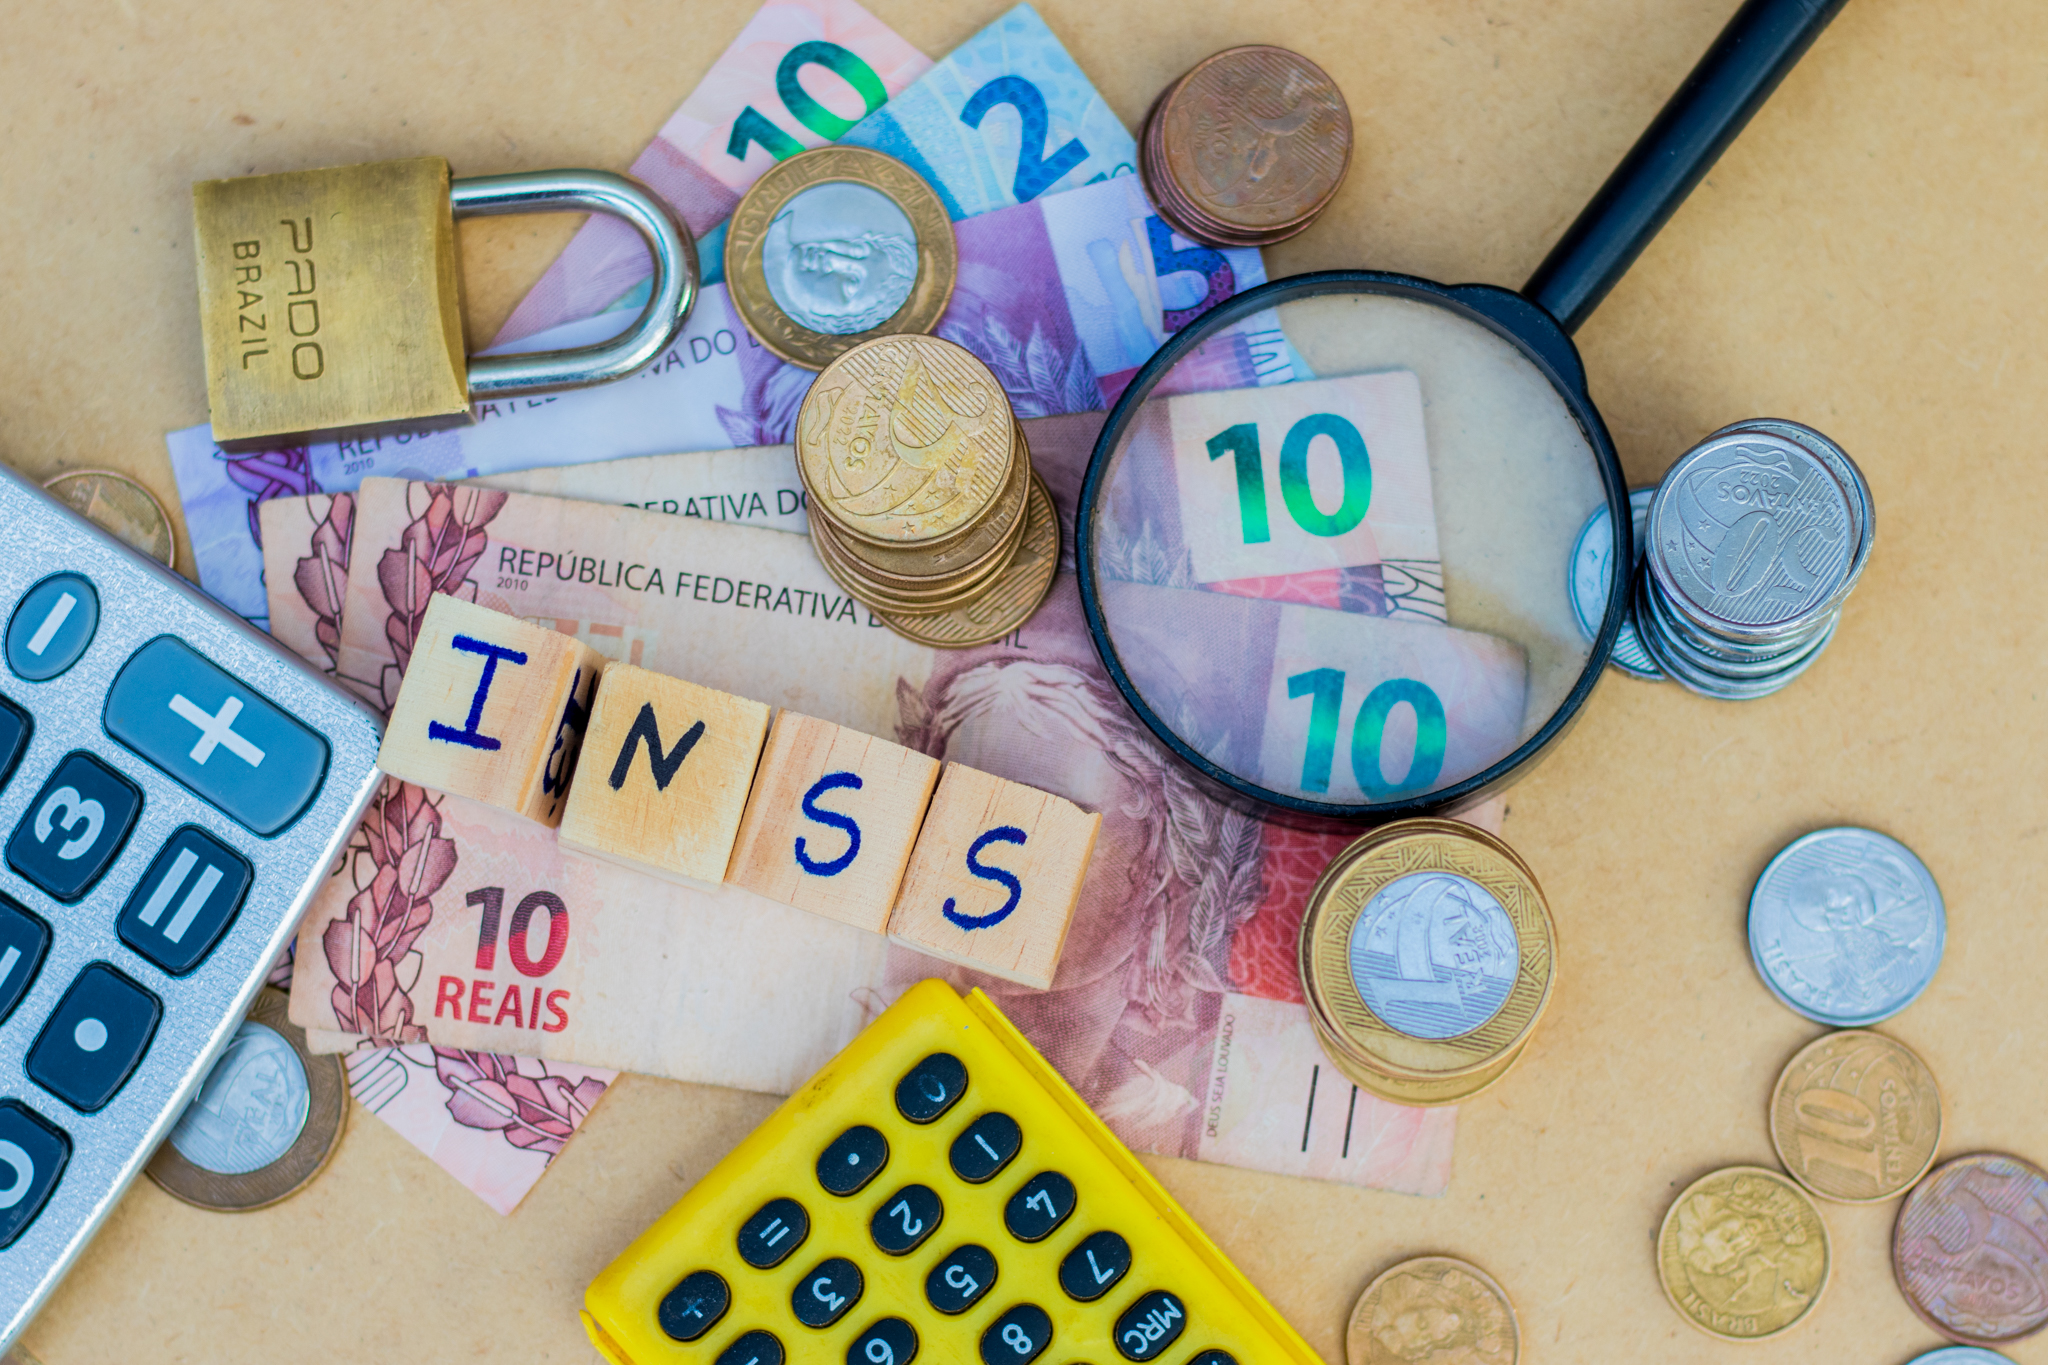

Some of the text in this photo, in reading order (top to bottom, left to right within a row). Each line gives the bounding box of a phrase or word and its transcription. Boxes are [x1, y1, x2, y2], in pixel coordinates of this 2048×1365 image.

[727, 40, 889, 164] 10
[960, 75, 1090, 204] 2
[735, 171, 794, 248] BRASIL
[232, 240, 269, 370] BRAZIL
[280, 217, 324, 380] PADO
[1145, 213, 1235, 333] 5
[689, 328, 737, 363] DO
[343, 457, 375, 476] 2010
[777, 489, 808, 515] D
[1205, 411, 1372, 545] 10
[1716, 481, 1837, 520] CENTAVOS
[1739, 470, 1780, 491] 2022
[496, 576, 529, 591] 2010
[498, 546, 857, 625] REPÚBLICA FEDERATIVA
[1710, 511, 1838, 605] 50
[1287, 666, 1447, 800] 10
[34, 785, 106, 861] 3
[466, 886, 570, 978] 10
[1443, 904, 1488, 995] REAL
[434, 974, 571, 1034] REAIS
[1206, 1013, 1236, 1138] DEUS SEJA LOUVADO
[1794, 1088, 1885, 1190] 10
[889, 1200, 923, 1236] 2
[1026, 1189, 1057, 1219] 4
[812, 1277, 846, 1312] 3
[945, 1264, 979, 1298] 5
[1086, 1249, 1115, 1284] 7
[1001, 1322, 1033, 1355] 8
[1123, 1297, 1183, 1354] MRC
